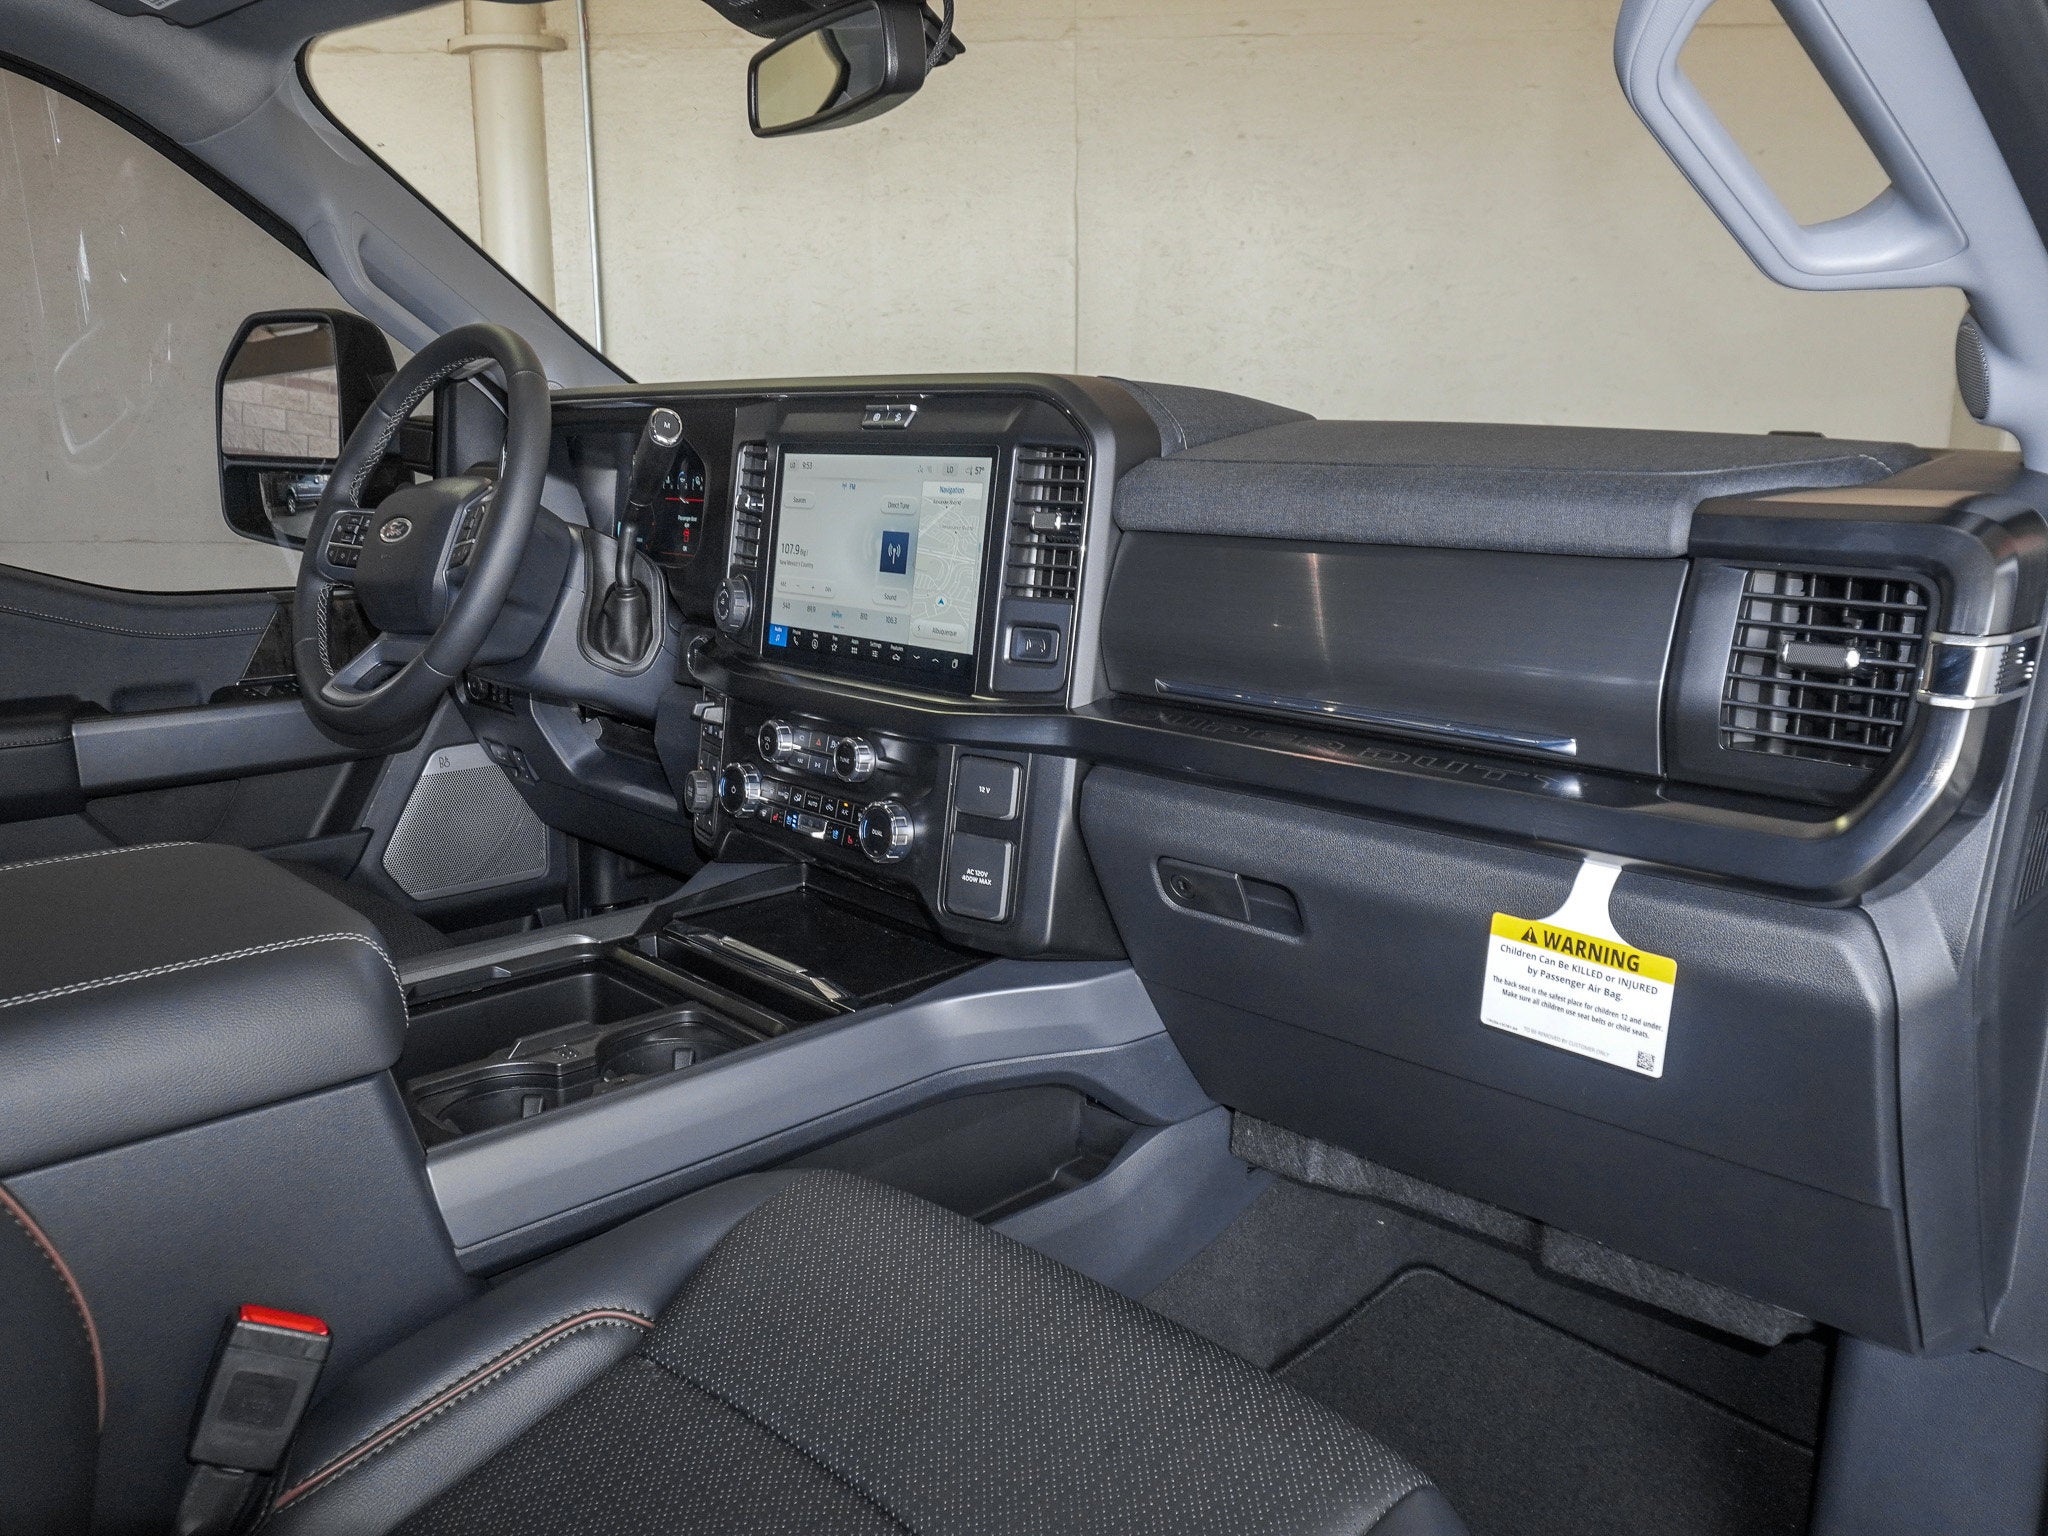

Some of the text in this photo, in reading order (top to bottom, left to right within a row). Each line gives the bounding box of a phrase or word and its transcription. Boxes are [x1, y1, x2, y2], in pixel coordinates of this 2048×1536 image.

[663, 421, 671, 429] M
[939, 486, 965, 495] Navigation
[781, 543, 800, 555] 107.9
[884, 592, 897, 600] Sound
[961, 874, 992, 886] 400W MAX
[966, 868, 989, 878] AC 120V
[1542, 929, 1641, 974] WARNING
[1500, 944, 1659, 996] Children Can Be KILLED or INJURED
[1527, 965, 1624, 1003] by Passenger Air Bag.
[1493, 974, 1664, 1033] The back seat is the safest place for children 12 and under.
[1502, 987, 1651, 1040] Make sure all children use seat belts or child seats.
[1523, 1025, 1531, 1033] TO
[1539, 1030, 1562, 1044] REMOVED
[1568, 1038, 1596, 1054] CUSTOMER
[1595, 1047, 1611, 1058] ONLY
